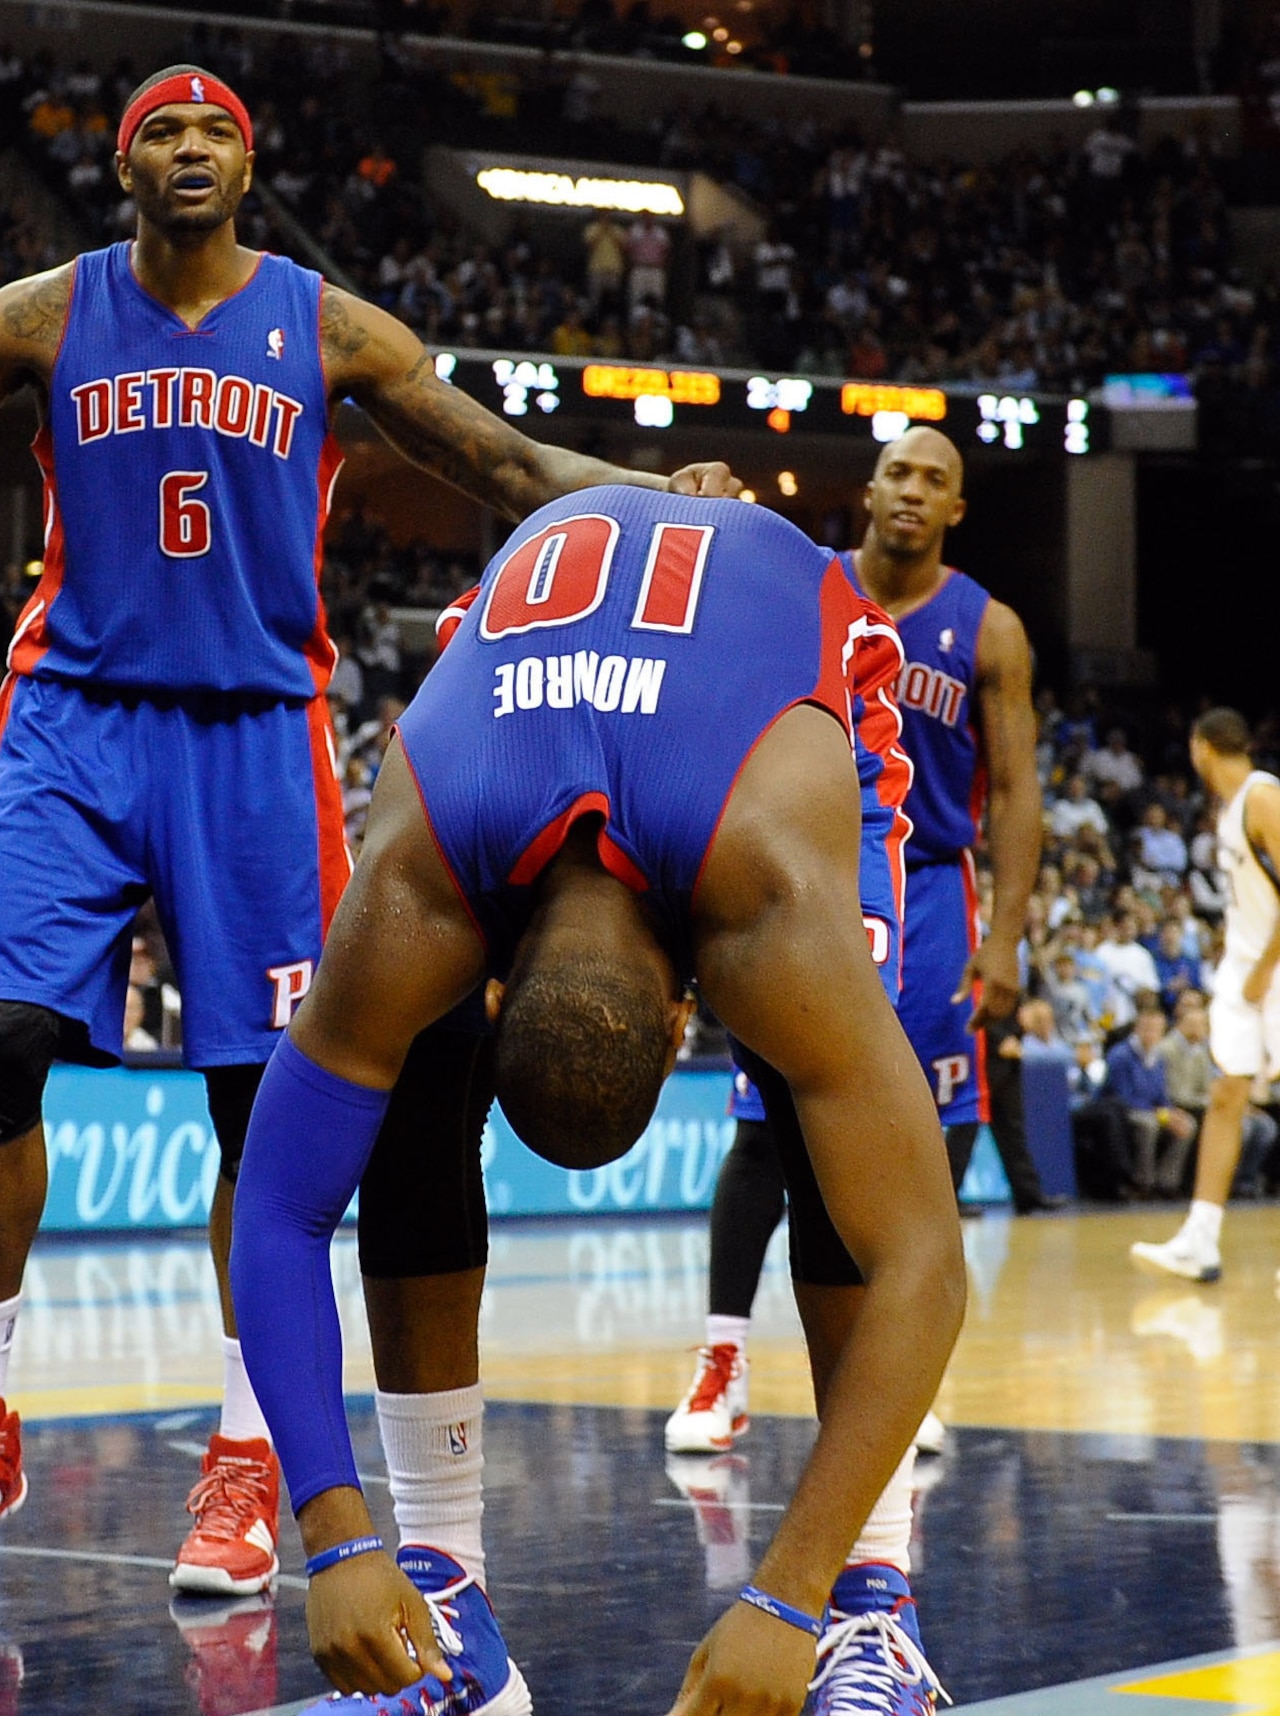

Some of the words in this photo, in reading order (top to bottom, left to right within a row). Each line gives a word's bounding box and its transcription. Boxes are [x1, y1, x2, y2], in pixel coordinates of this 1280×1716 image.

[71, 367, 303, 459] DETROIT
[159, 471, 211, 557] 6
[479, 513, 717, 644] 10
[493, 650, 667, 718] MONROE
[267, 958, 314, 1031] P
[932, 1053, 969, 1106] P
